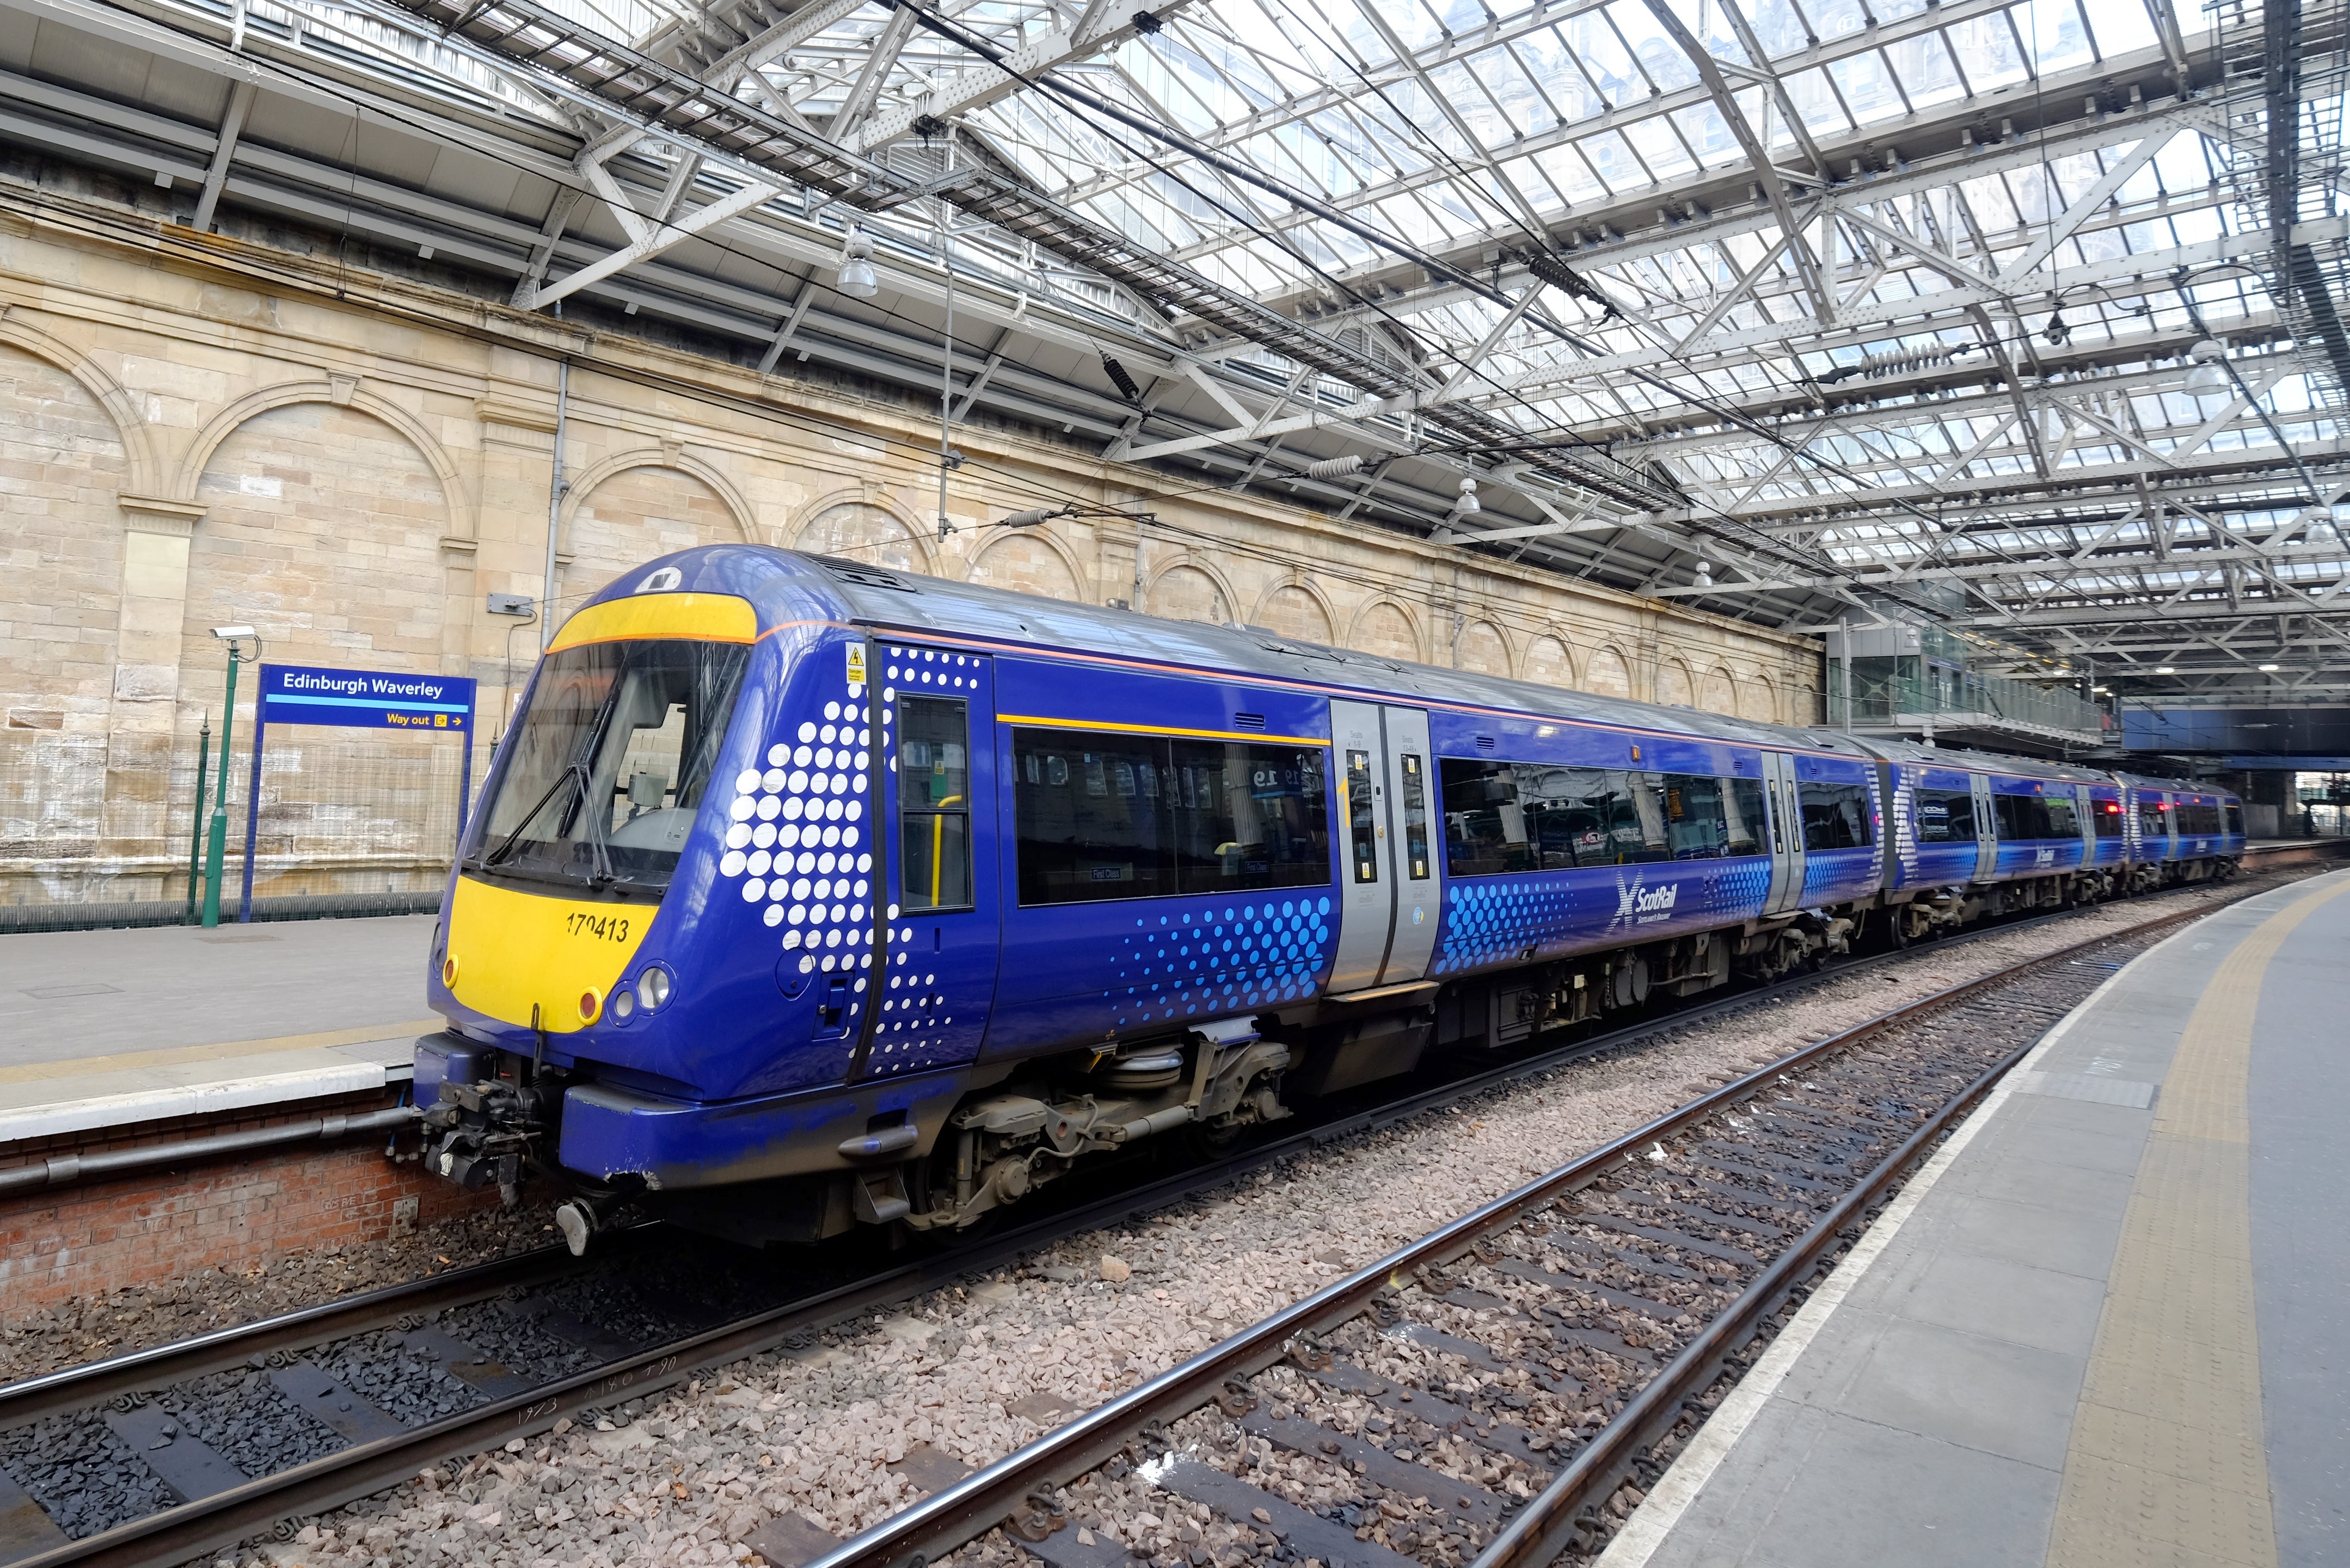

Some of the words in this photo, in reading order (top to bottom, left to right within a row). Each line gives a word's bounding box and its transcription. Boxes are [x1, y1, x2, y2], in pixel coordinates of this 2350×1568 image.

[283, 673, 367, 695] Edinburgh
[372, 678, 443, 699] Waverley
[387, 713, 409, 725] Way
[412, 715, 429, 725] out
[1350, 730, 1363, 739] Seats
[1402, 735, 1414, 743] Seats
[1337, 777, 1350, 827] 1
[1093, 869, 1105, 879] First
[1106, 869, 1120, 878] Class
[1635, 883, 1678, 913] ScotRail
[518, 1397, 557, 1425] 1973
